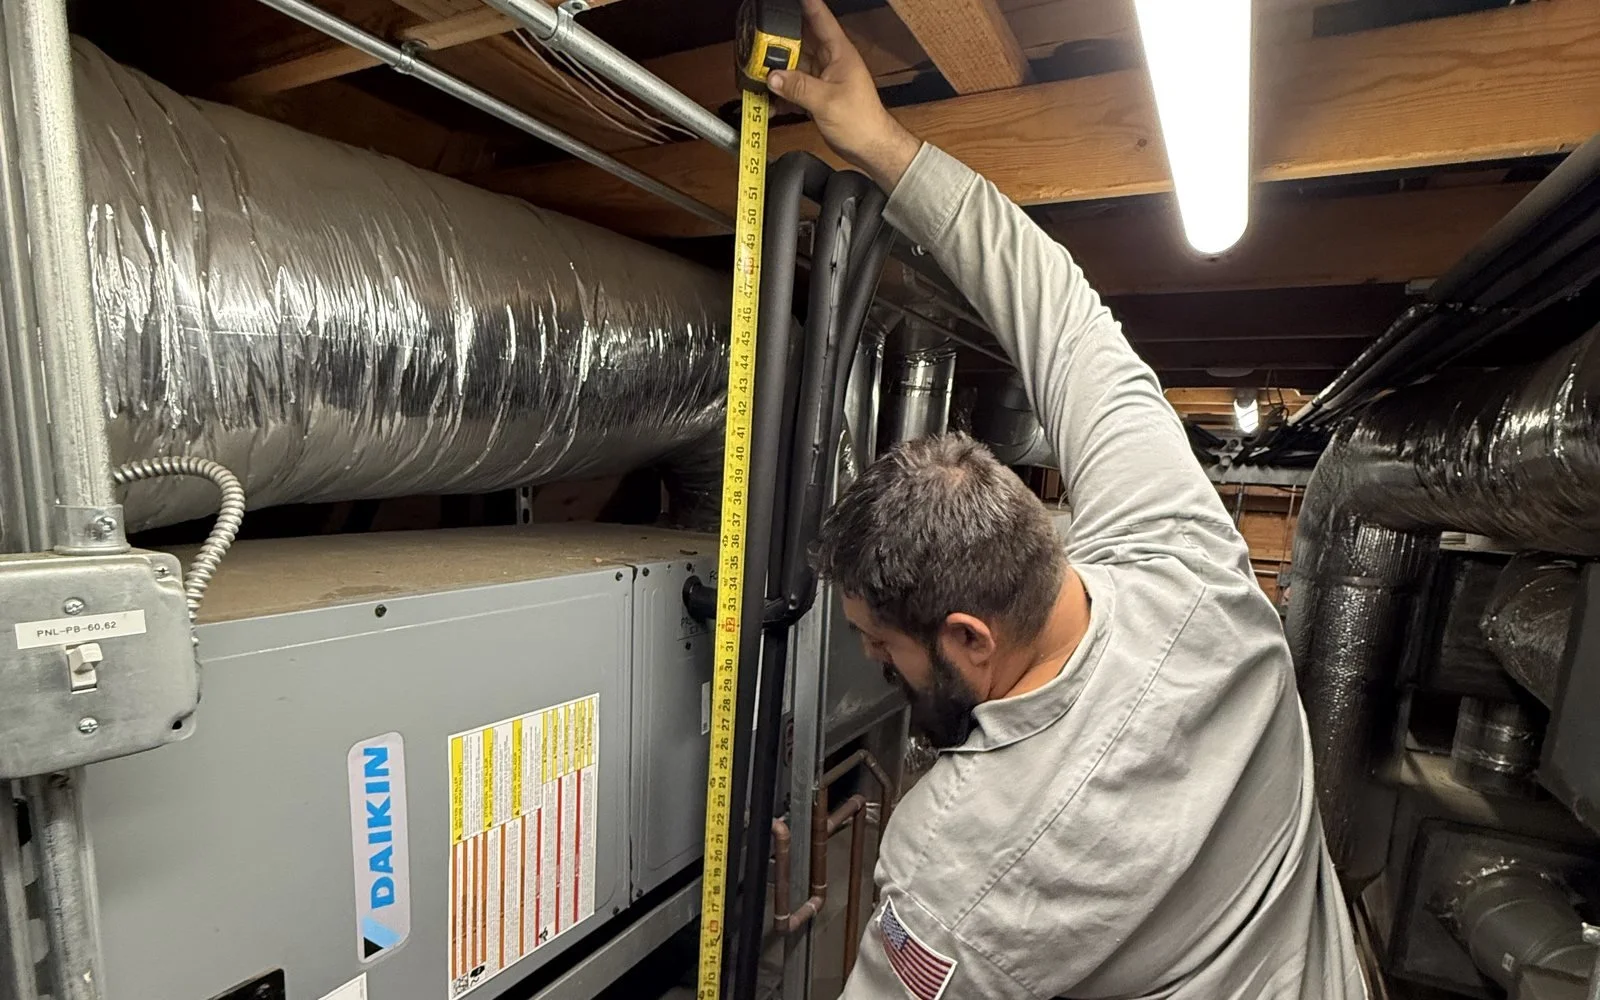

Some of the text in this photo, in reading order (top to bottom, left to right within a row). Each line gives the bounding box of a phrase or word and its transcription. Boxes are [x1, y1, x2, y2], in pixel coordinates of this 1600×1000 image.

[753, 106, 762, 123] 54
[751, 132, 760, 149] 53
[750, 157, 759, 174] 52
[748, 186, 758, 200] 51
[747, 208, 757, 225] 50
[746, 234, 756, 250] 49
[744, 282, 753, 299] 47
[743, 307, 752, 323] 46
[741, 331, 751, 346] 45
[740, 354, 749, 370] 44
[739, 378, 748, 393] 43
[738, 401, 747, 416] 42
[737, 426, 746, 439] 41
[735, 446, 745, 461] 40
[734, 468, 744, 483] 39
[733, 490, 742, 505] 38
[732, 512, 741, 527] 37
[731, 534, 740, 548] 36
[730, 555, 739, 570] 35
[729, 577, 738, 591] 34
[728, 597, 737, 612] 33
[726, 641, 734, 652] 31
[724, 658, 733, 672] 30
[723, 678, 732, 692] 29
[722, 698, 731, 712] 28
[721, 718, 730, 731] 27
[720, 737, 729, 750] 26
[719, 756, 728, 769] 25
[718, 776, 727, 789] 24
[717, 794, 726, 807] 23
[716, 813, 725, 826] 22
[363, 747, 395, 910] DAIKIN
[715, 833, 723, 844] 21
[714, 849, 723, 862] 20
[713, 867, 721, 878] 19
[711, 903, 719, 912] 17
